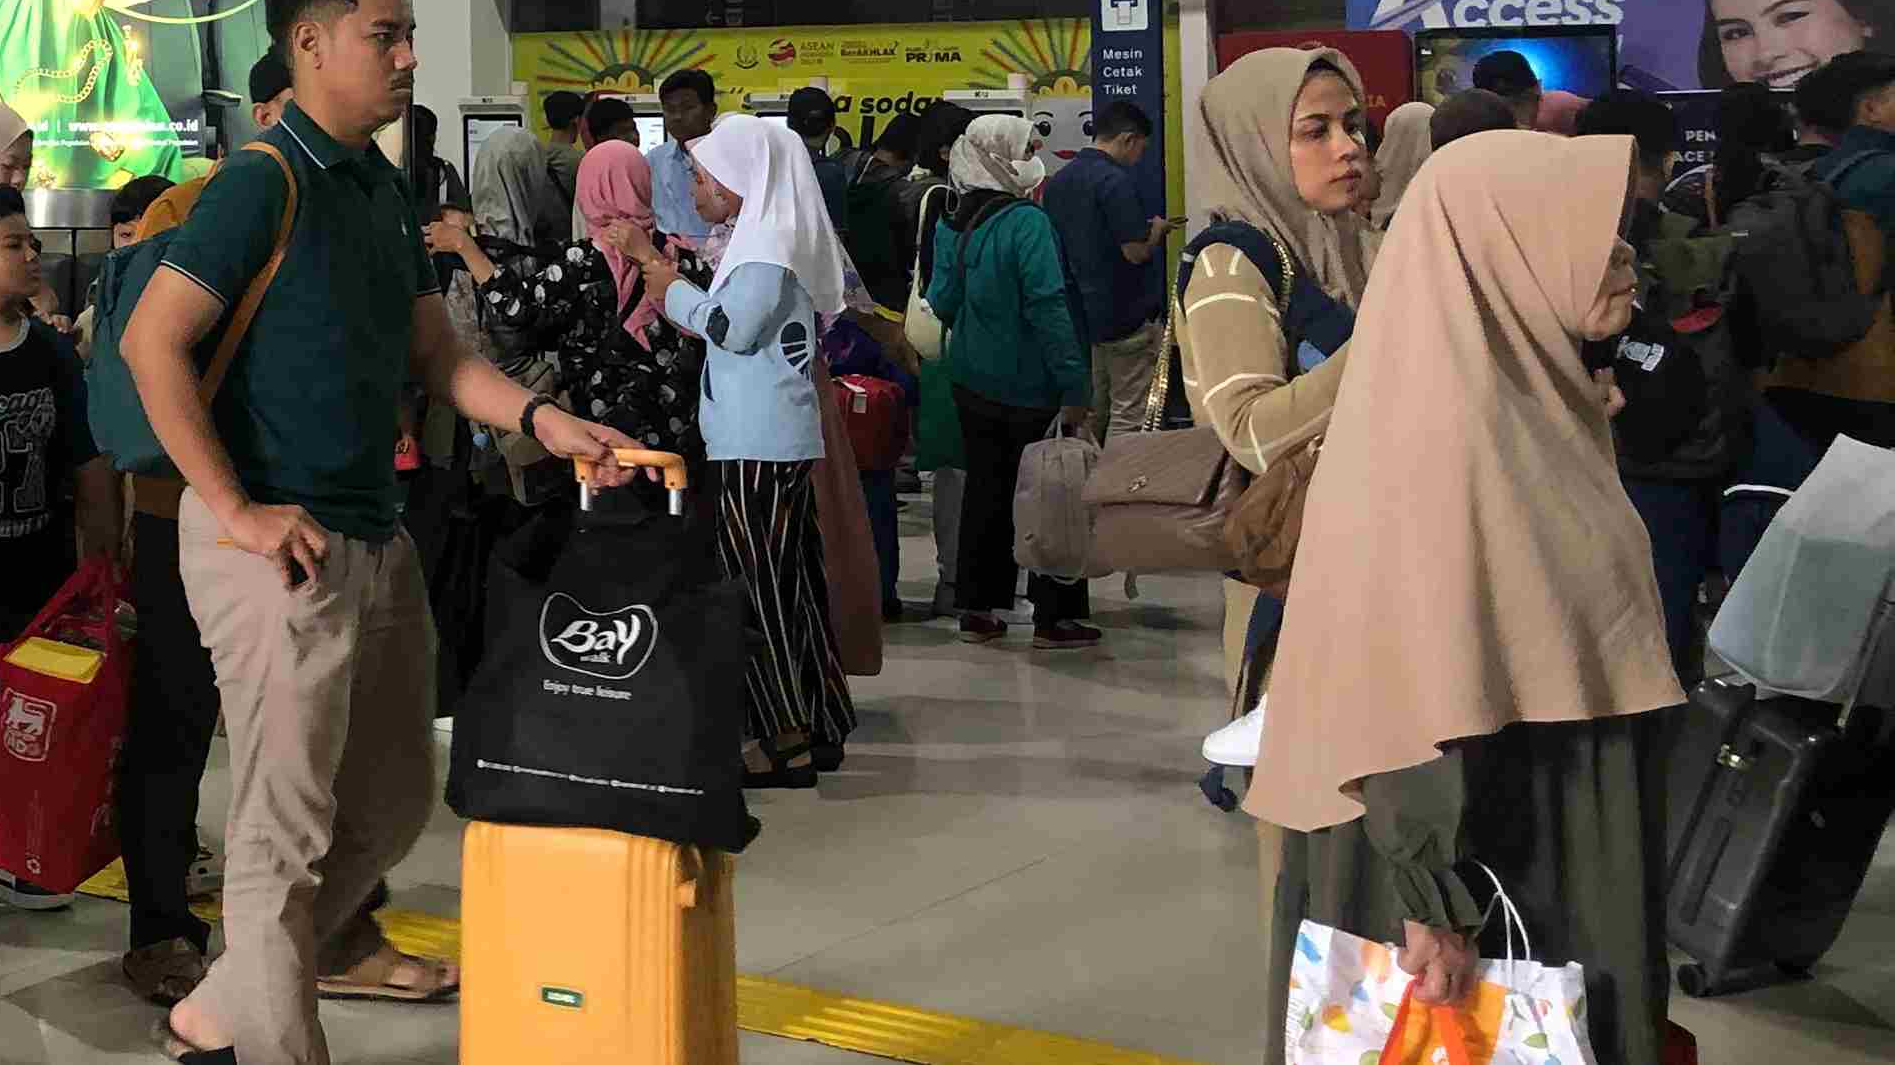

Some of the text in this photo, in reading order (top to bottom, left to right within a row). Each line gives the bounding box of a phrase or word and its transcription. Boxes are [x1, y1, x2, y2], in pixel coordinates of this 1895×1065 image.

[1103, 48, 1143, 60] Mesin
[1103, 66, 1143, 78] Cetak
[1103, 84, 1138, 96] Tiket
[543, 679, 570, 695] Enjoy
